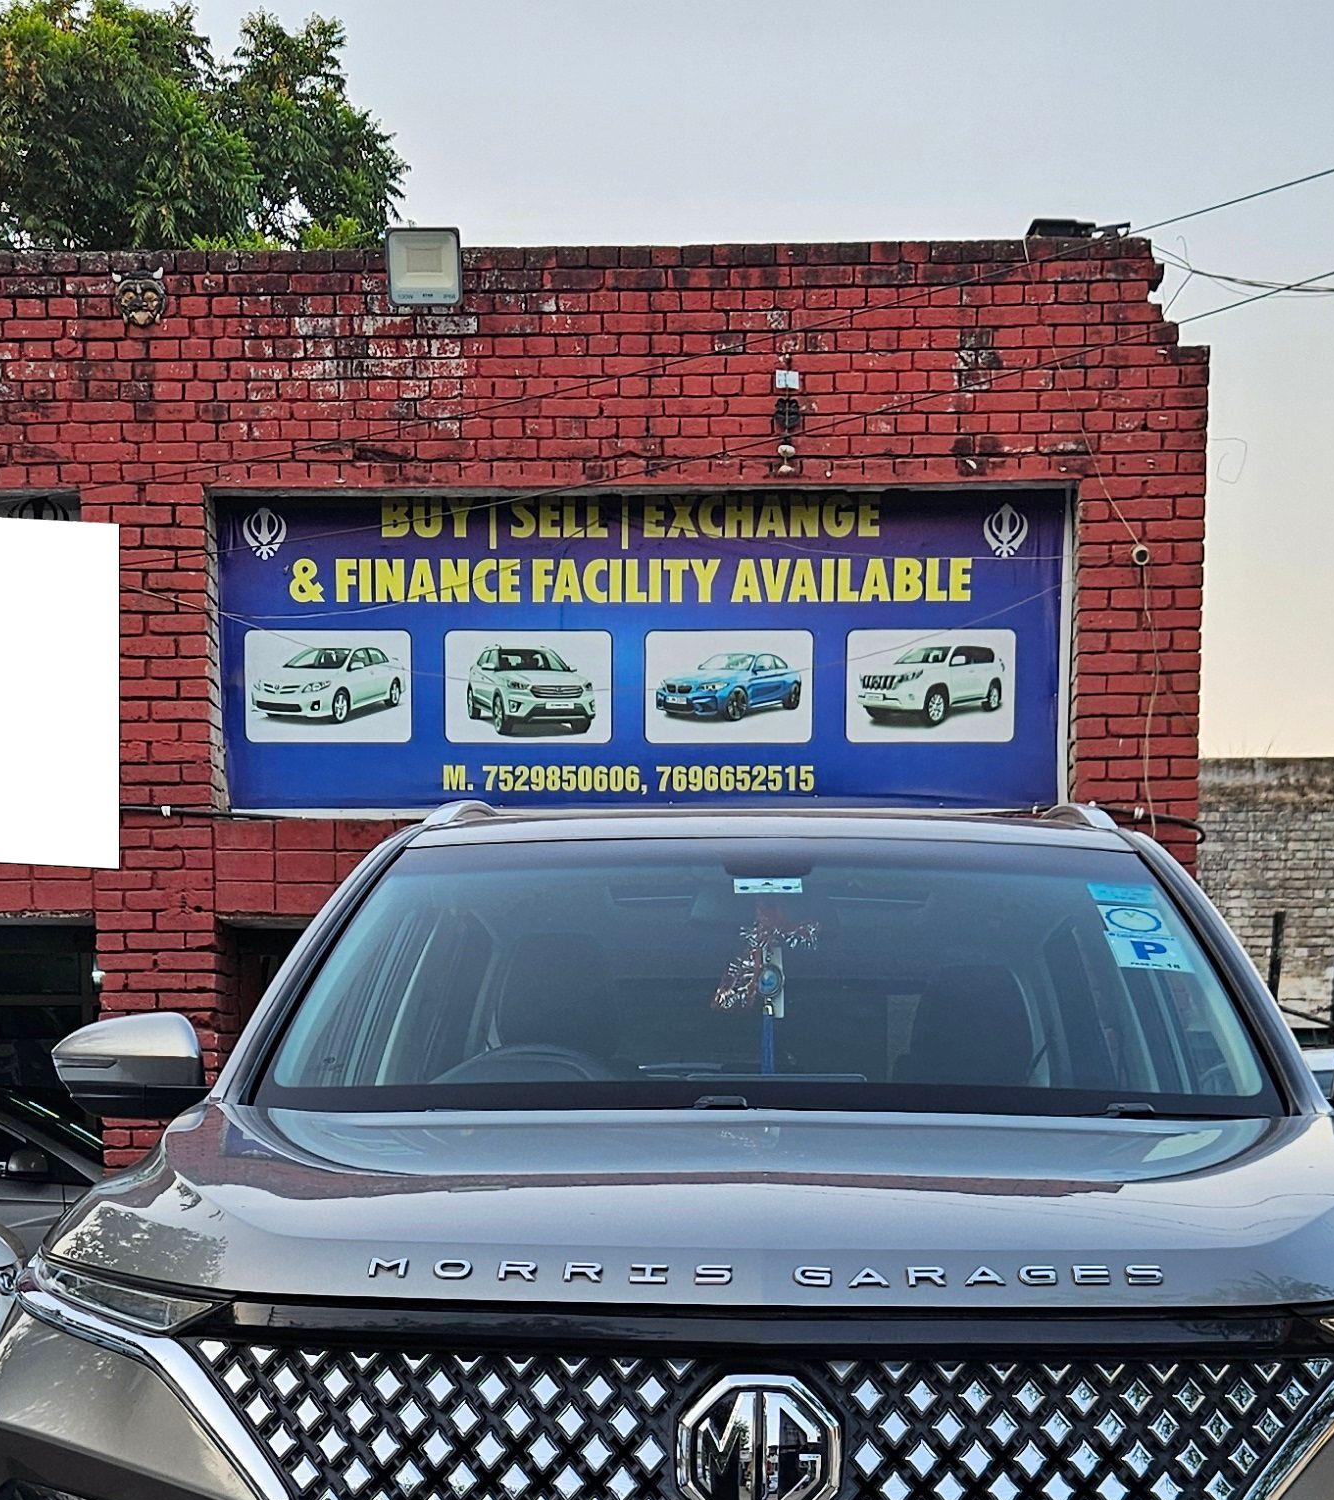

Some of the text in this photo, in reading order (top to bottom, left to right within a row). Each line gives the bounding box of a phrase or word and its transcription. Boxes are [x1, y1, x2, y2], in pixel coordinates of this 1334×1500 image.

[381, 496, 470, 538] BUY
[510, 496, 609, 538] SELL
[643, 496, 881, 538] EXCHANGE
[289, 558, 973, 603] & FINANCE FACILITY AVAILABLE
[442, 765, 815, 795] M. 7529850606, 7696652515
[1130, 940, 1167, 960] P
[368, 1257, 1164, 1287] MORRIS GARAGES
